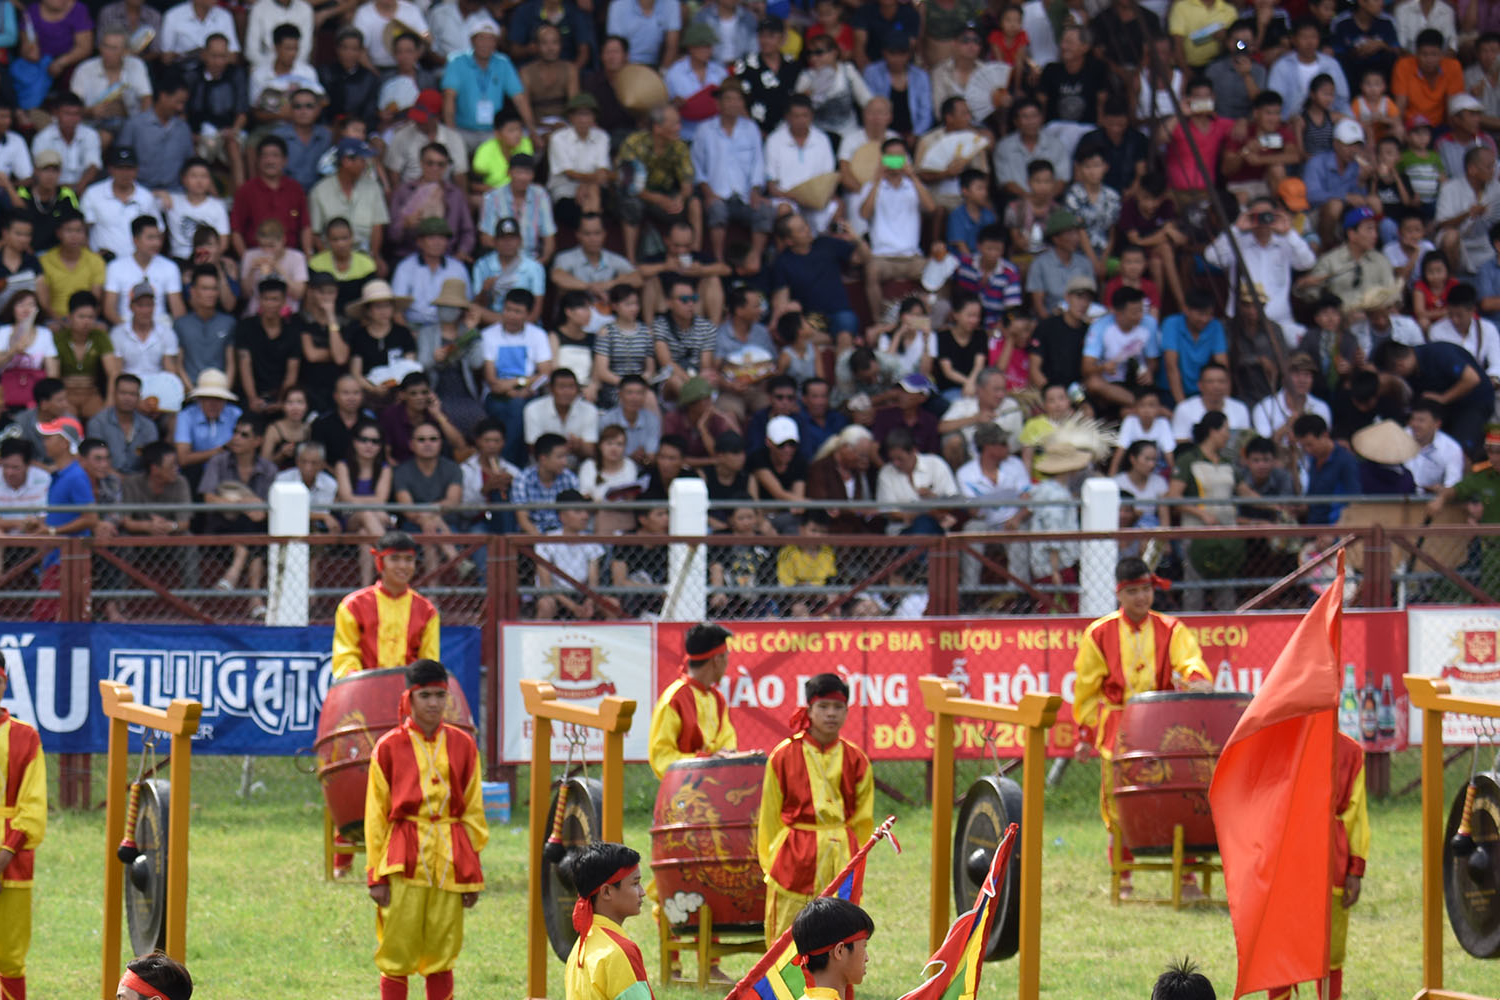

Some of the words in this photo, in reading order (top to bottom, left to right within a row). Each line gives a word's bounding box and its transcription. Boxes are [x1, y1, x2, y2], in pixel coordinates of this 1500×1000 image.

[726, 631, 757, 652] NG
[761, 628, 823, 652] CÔNG
[824, 632, 853, 652] TY
[856, 632, 884, 652] CP
[888, 631, 923, 651] BIA
[1017, 629, 1064, 650] NGK
[872, 711, 916, 750] ĐỒ
